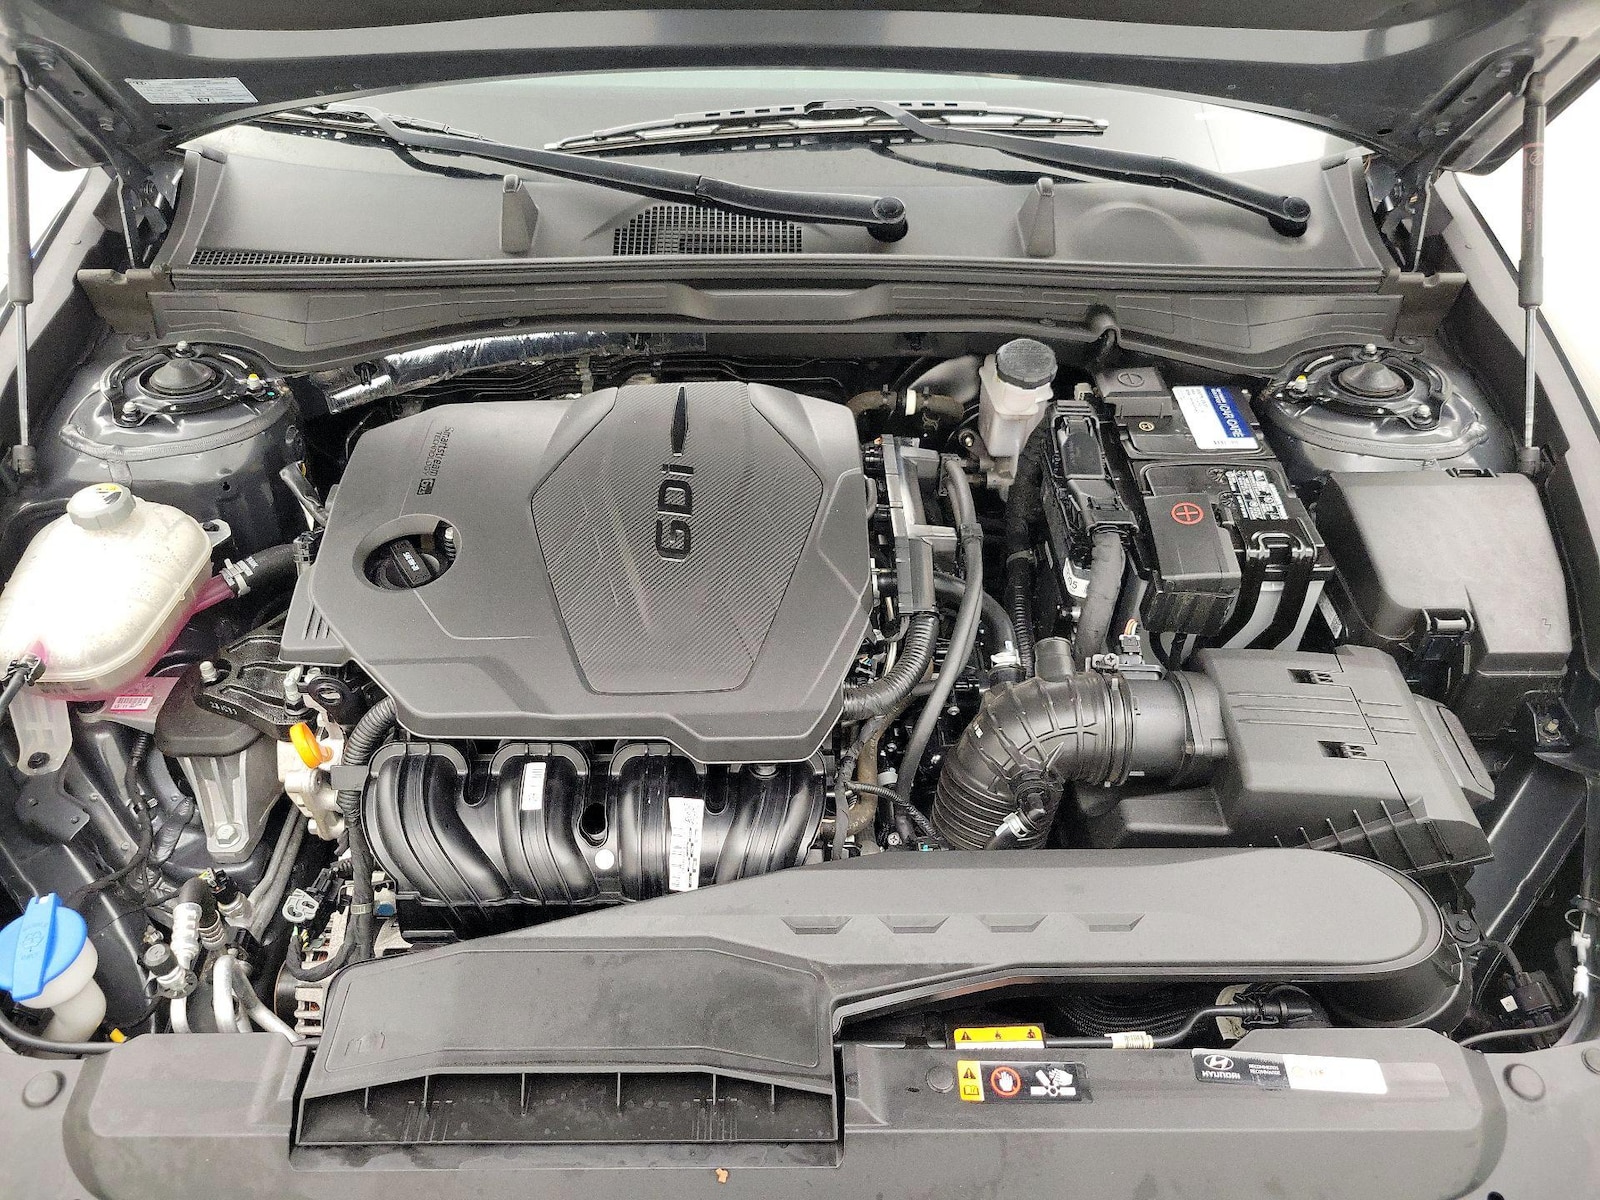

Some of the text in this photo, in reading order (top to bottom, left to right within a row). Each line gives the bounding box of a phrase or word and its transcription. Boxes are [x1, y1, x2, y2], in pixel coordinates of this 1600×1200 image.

[423, 431, 443, 476] TECHNOLOGY
[430, 426, 455, 477] Smartstream
[1201, 1070, 1241, 1080] HYUNDAI
